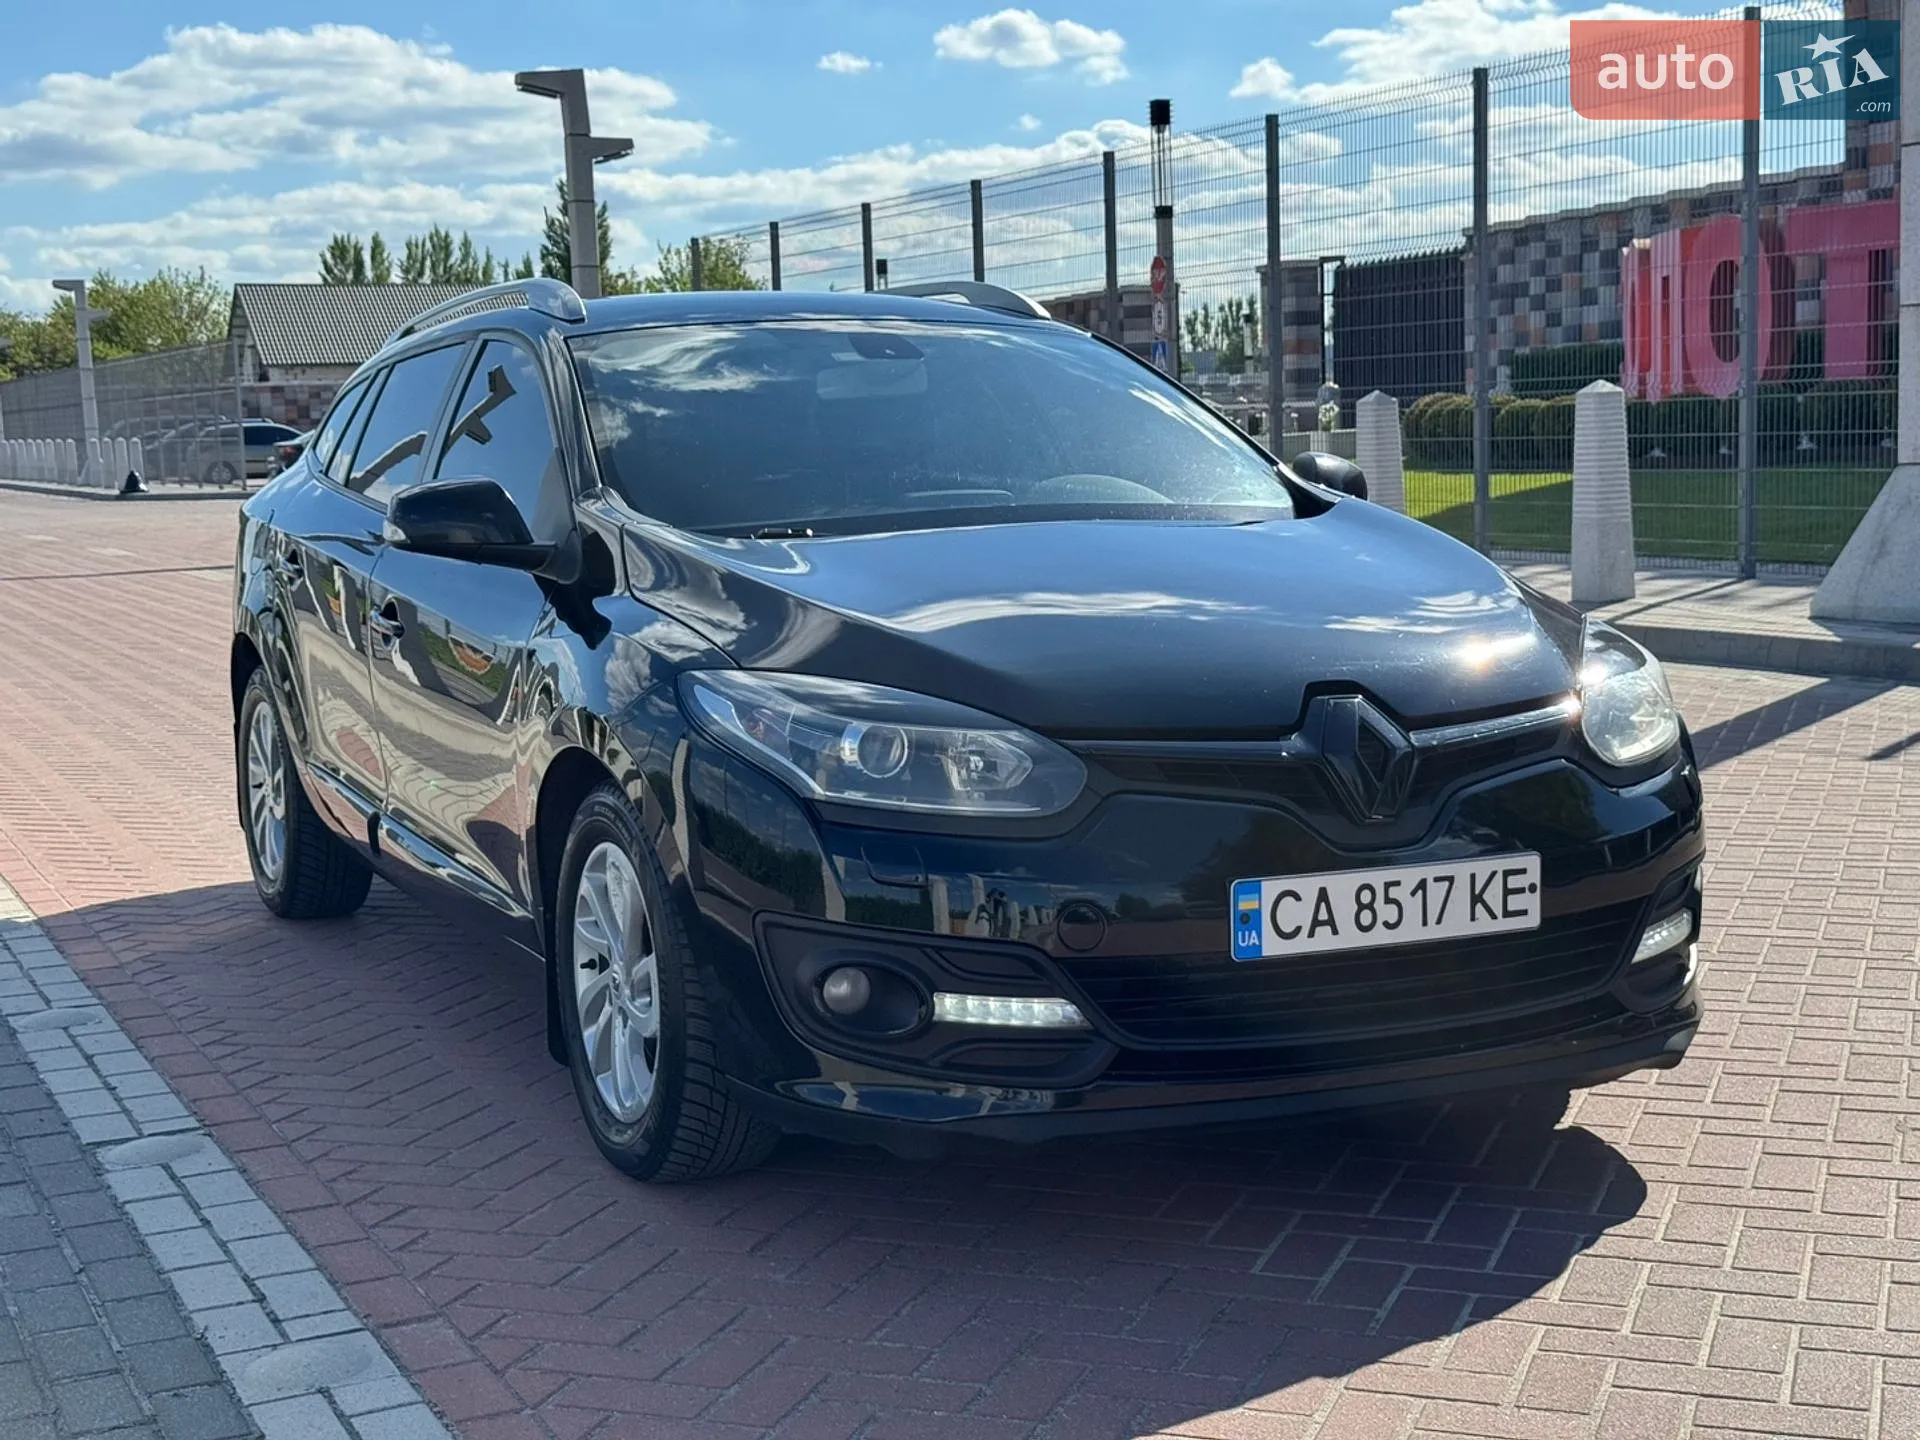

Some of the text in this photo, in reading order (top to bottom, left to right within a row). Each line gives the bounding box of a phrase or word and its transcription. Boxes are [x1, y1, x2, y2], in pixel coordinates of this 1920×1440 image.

[1269, 867, 1528, 941] CA 8517 KE
[1238, 931, 1259, 946] UA
